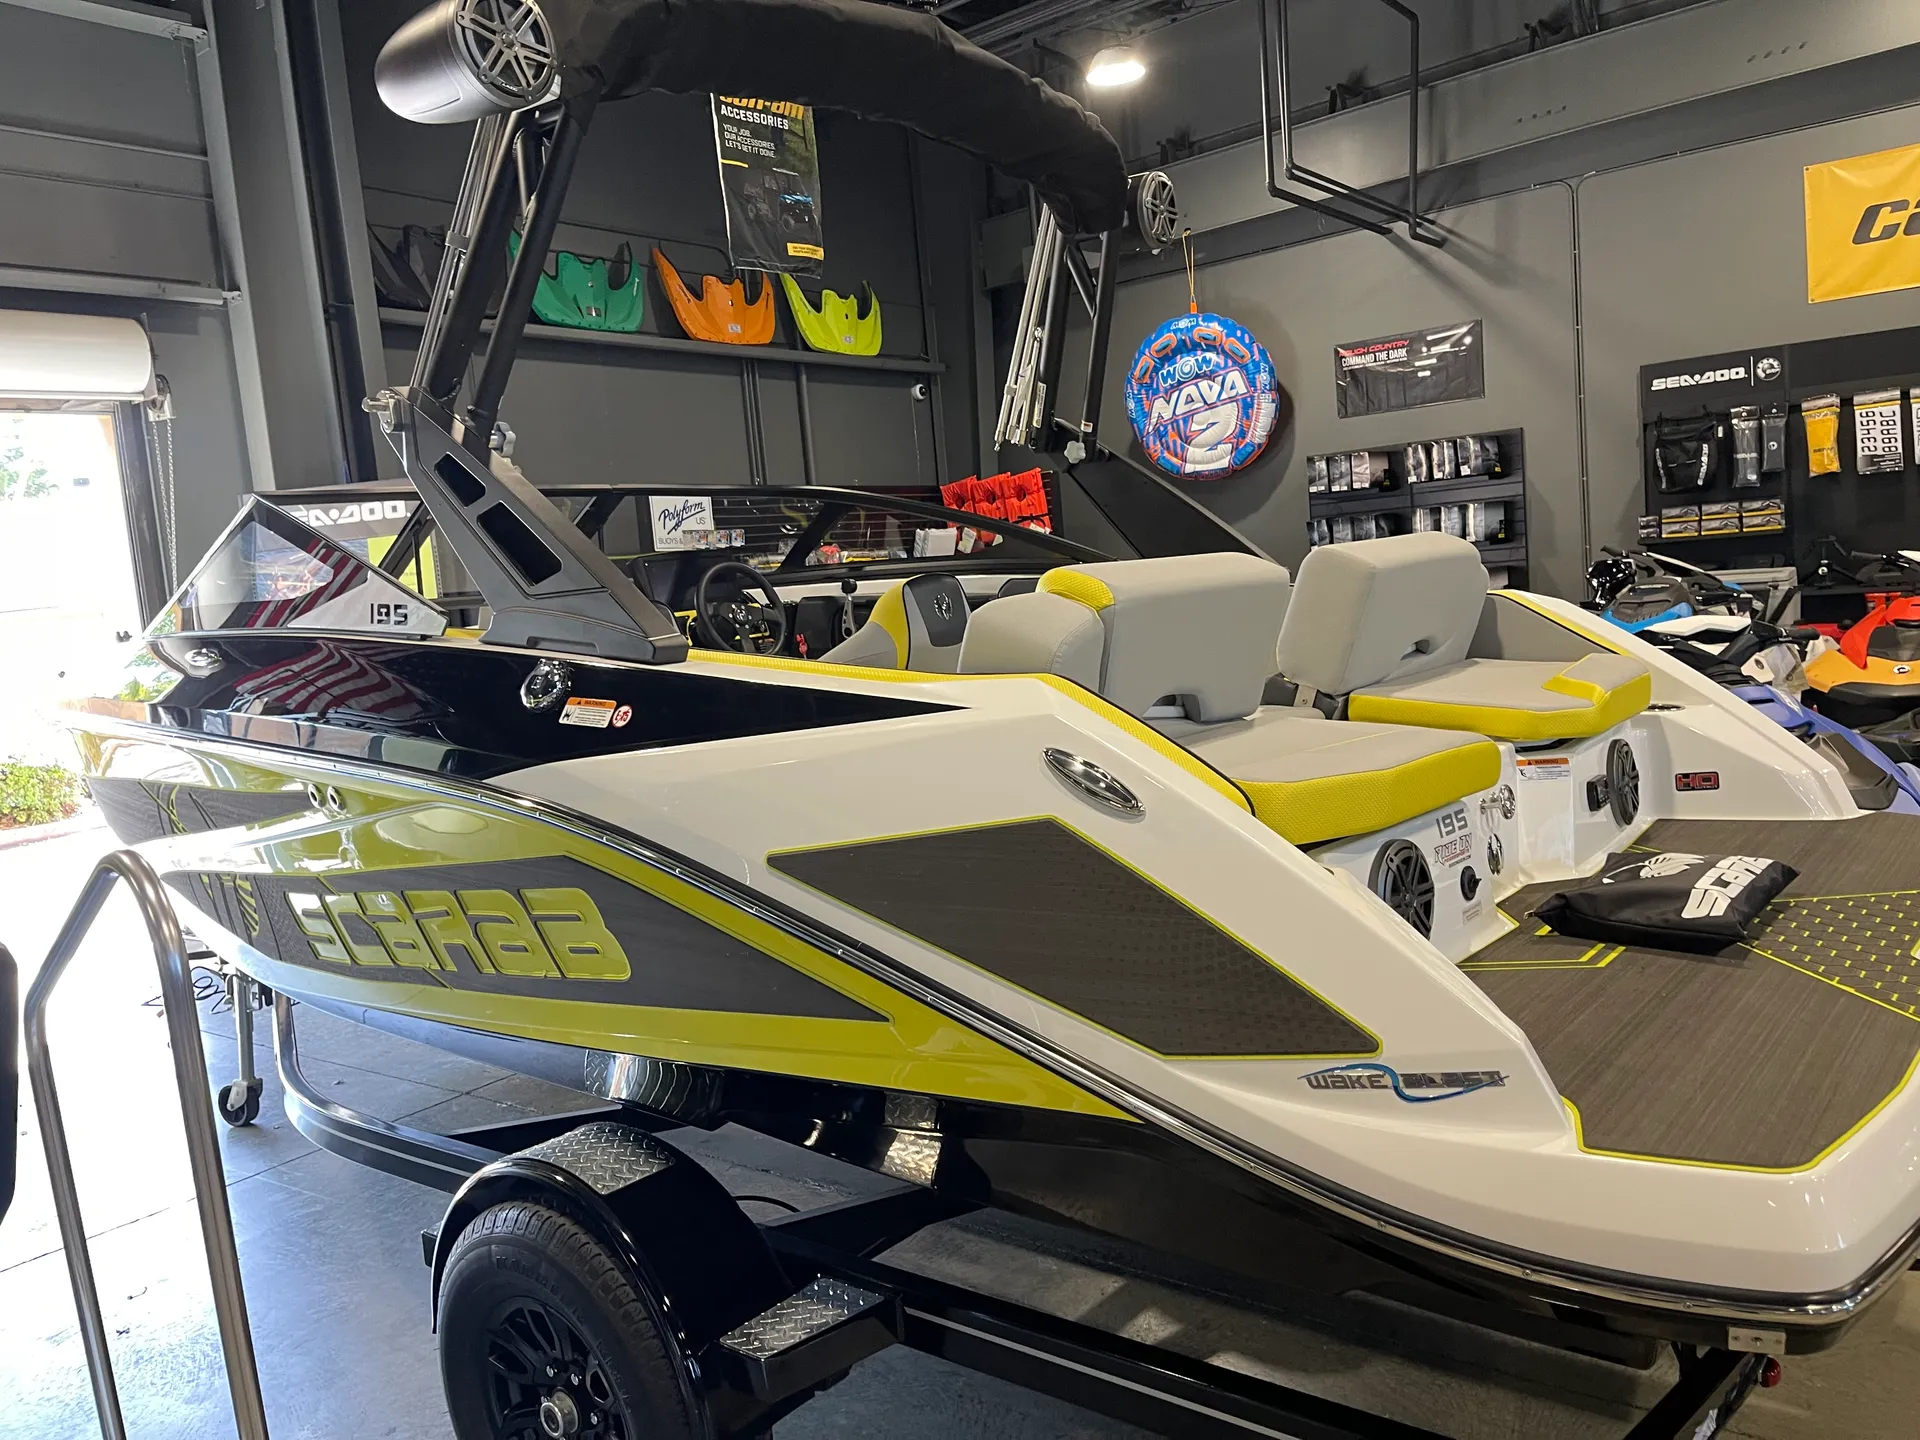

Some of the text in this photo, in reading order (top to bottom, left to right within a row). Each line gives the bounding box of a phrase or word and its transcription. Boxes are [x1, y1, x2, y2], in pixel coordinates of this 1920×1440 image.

[720, 104, 789, 130] ACCESSORIES
[723, 124, 738, 133] YOUR
[724, 132, 737, 142] OUR
[741, 145, 751, 153] GET
[1341, 352, 1374, 367] COMMAND
[1375, 351, 1388, 361] THE
[1389, 347, 1407, 359] DARK
[1159, 354, 1216, 387] WOW
[1149, 370, 1248, 432] NAVA
[696, 516, 706, 525] US
[658, 537, 676, 545] BUOYS
[370, 603, 408, 626] 195
[1436, 808, 1468, 838] 195
[285, 888, 632, 981] SCARAB
